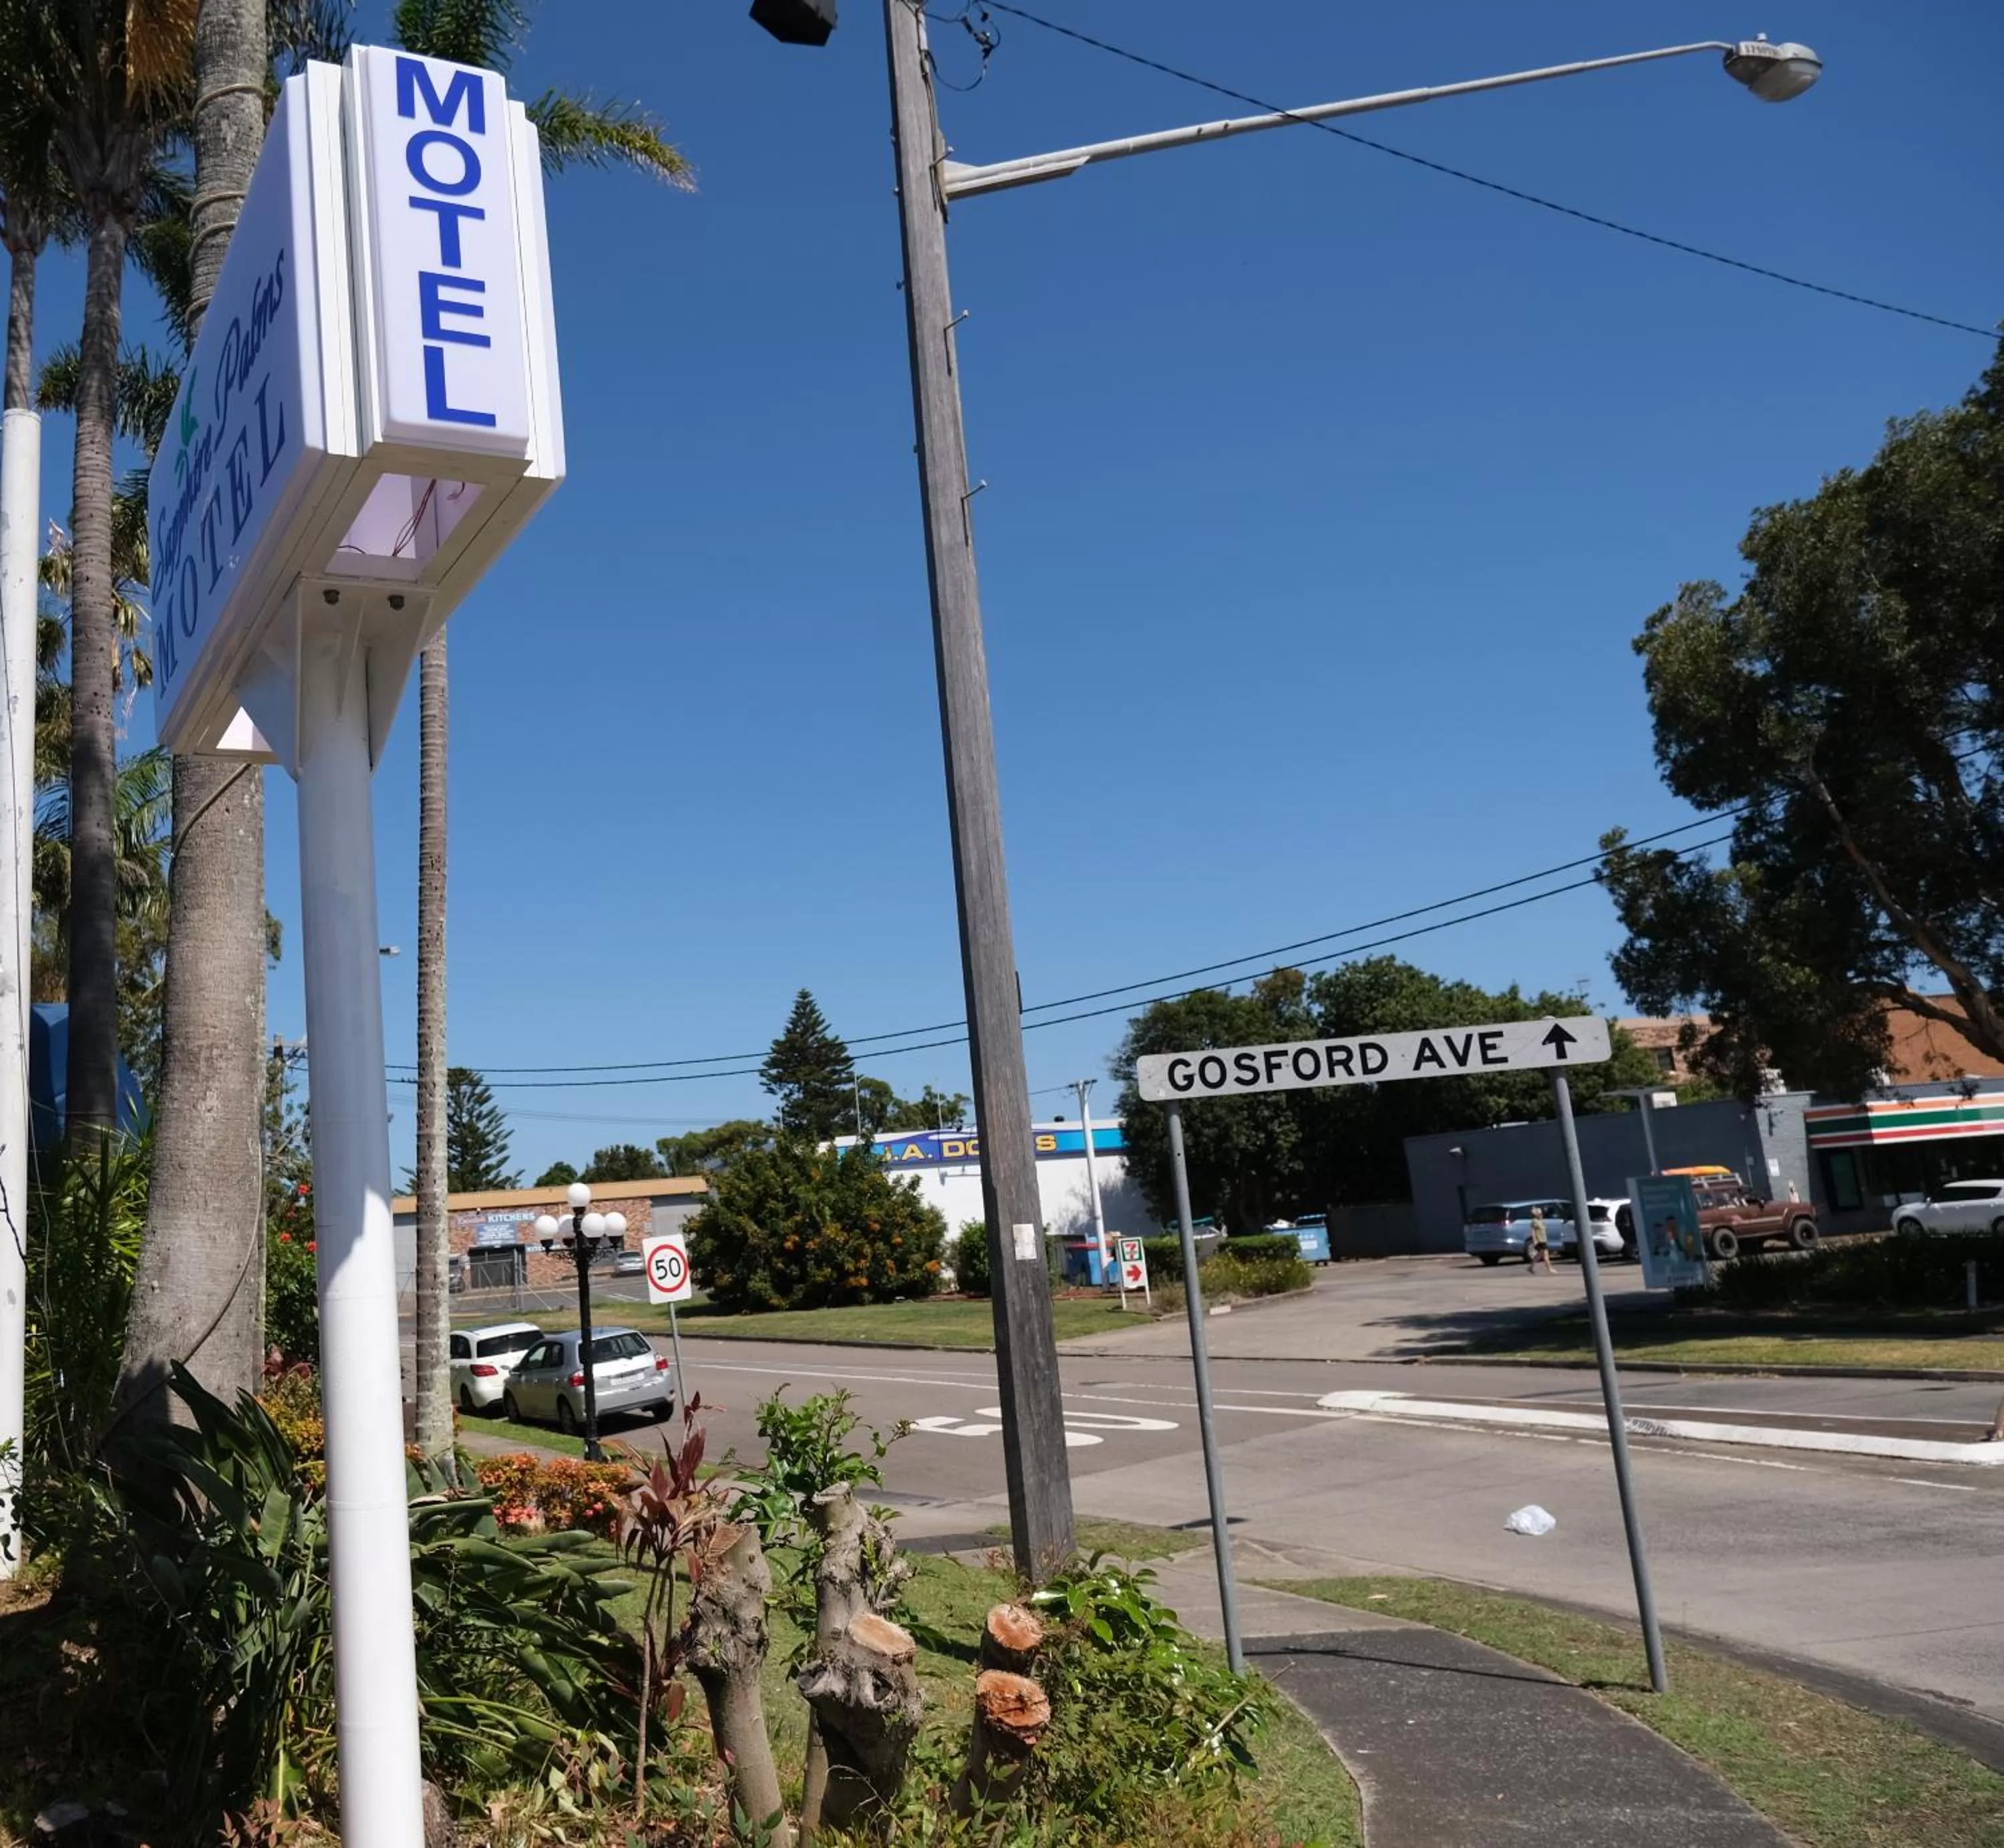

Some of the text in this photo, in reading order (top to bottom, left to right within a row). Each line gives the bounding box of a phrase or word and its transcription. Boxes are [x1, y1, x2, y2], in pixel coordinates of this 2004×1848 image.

[395, 55, 496, 428] MOTEL
[214, 248, 284, 453] Palms
[155, 373, 286, 699] MOTEL
[1168, 1031, 1509, 1092] GOSFORD AVE
[488, 1212, 535, 1223] KITCHENS
[655, 1257, 681, 1280] 50
